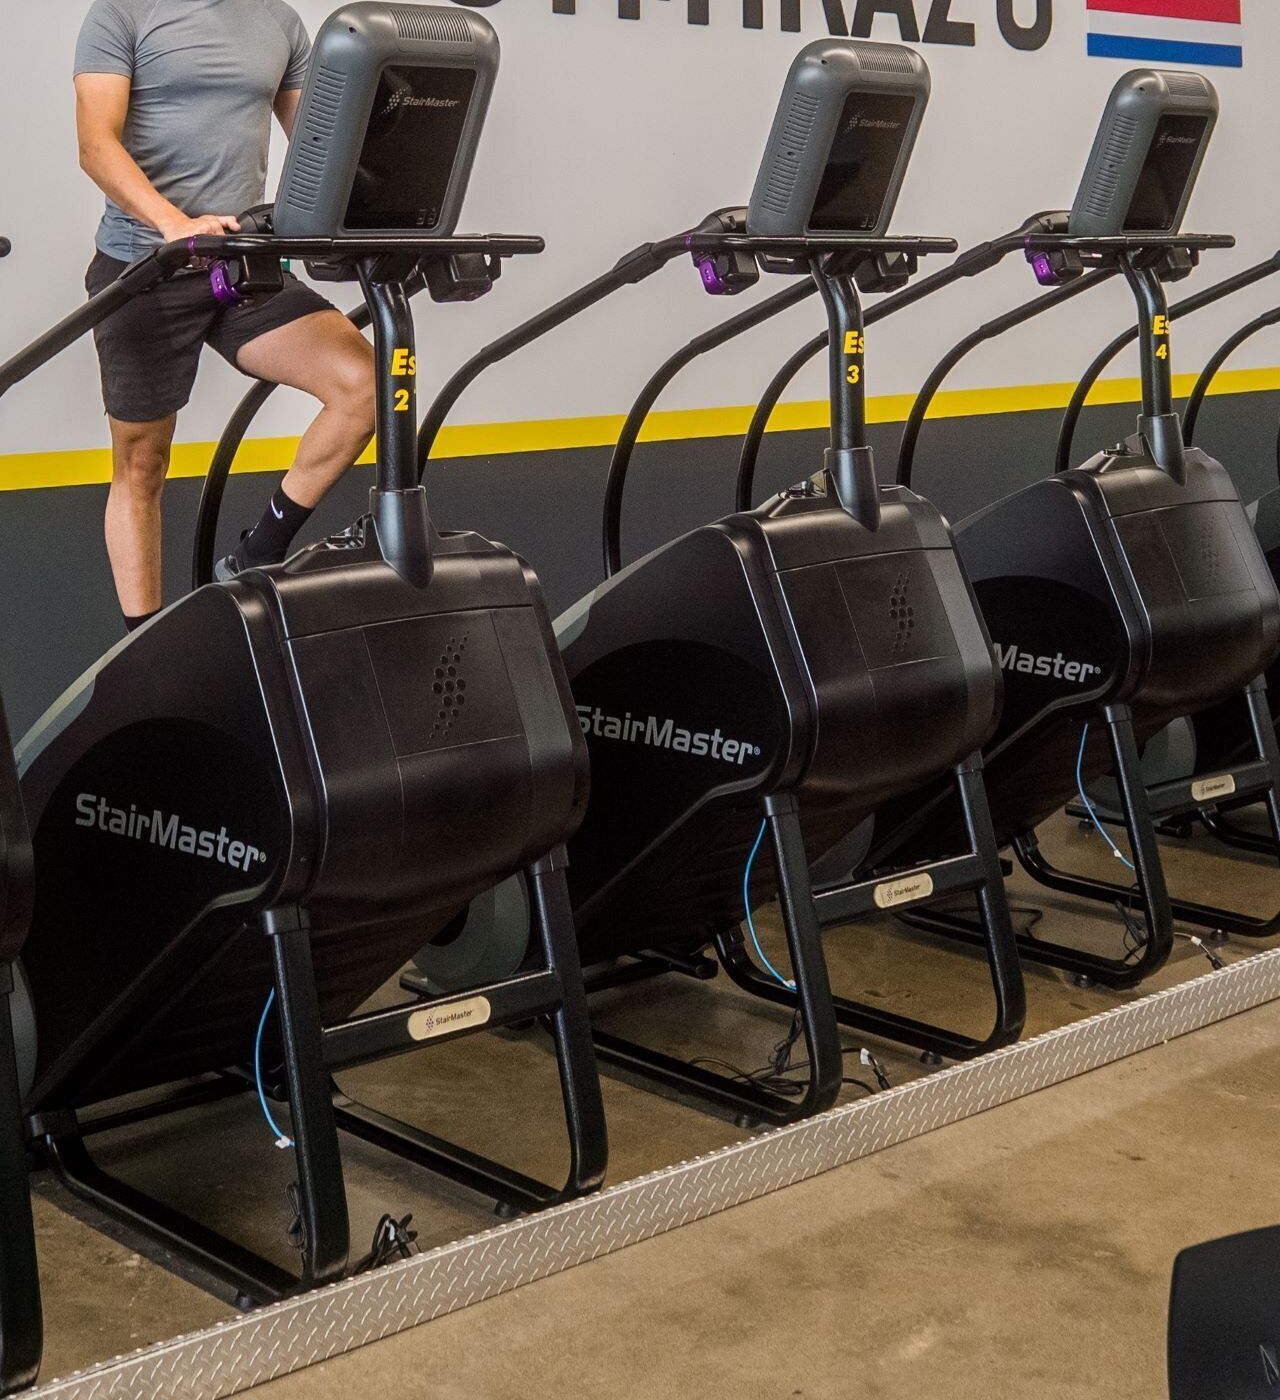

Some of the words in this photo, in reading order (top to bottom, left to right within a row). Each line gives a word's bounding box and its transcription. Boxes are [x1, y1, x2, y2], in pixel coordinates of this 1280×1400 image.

[402, 96, 458, 107] StairMaster
[390, 348, 416, 376] Es
[1155, 343, 1167, 360] 4
[846, 364, 859, 384] 3
[394, 389, 409, 411] 2
[993, 642, 1094, 683] Master
[575, 705, 754, 765] StairMaster
[75, 793, 259, 872] StairMaster
